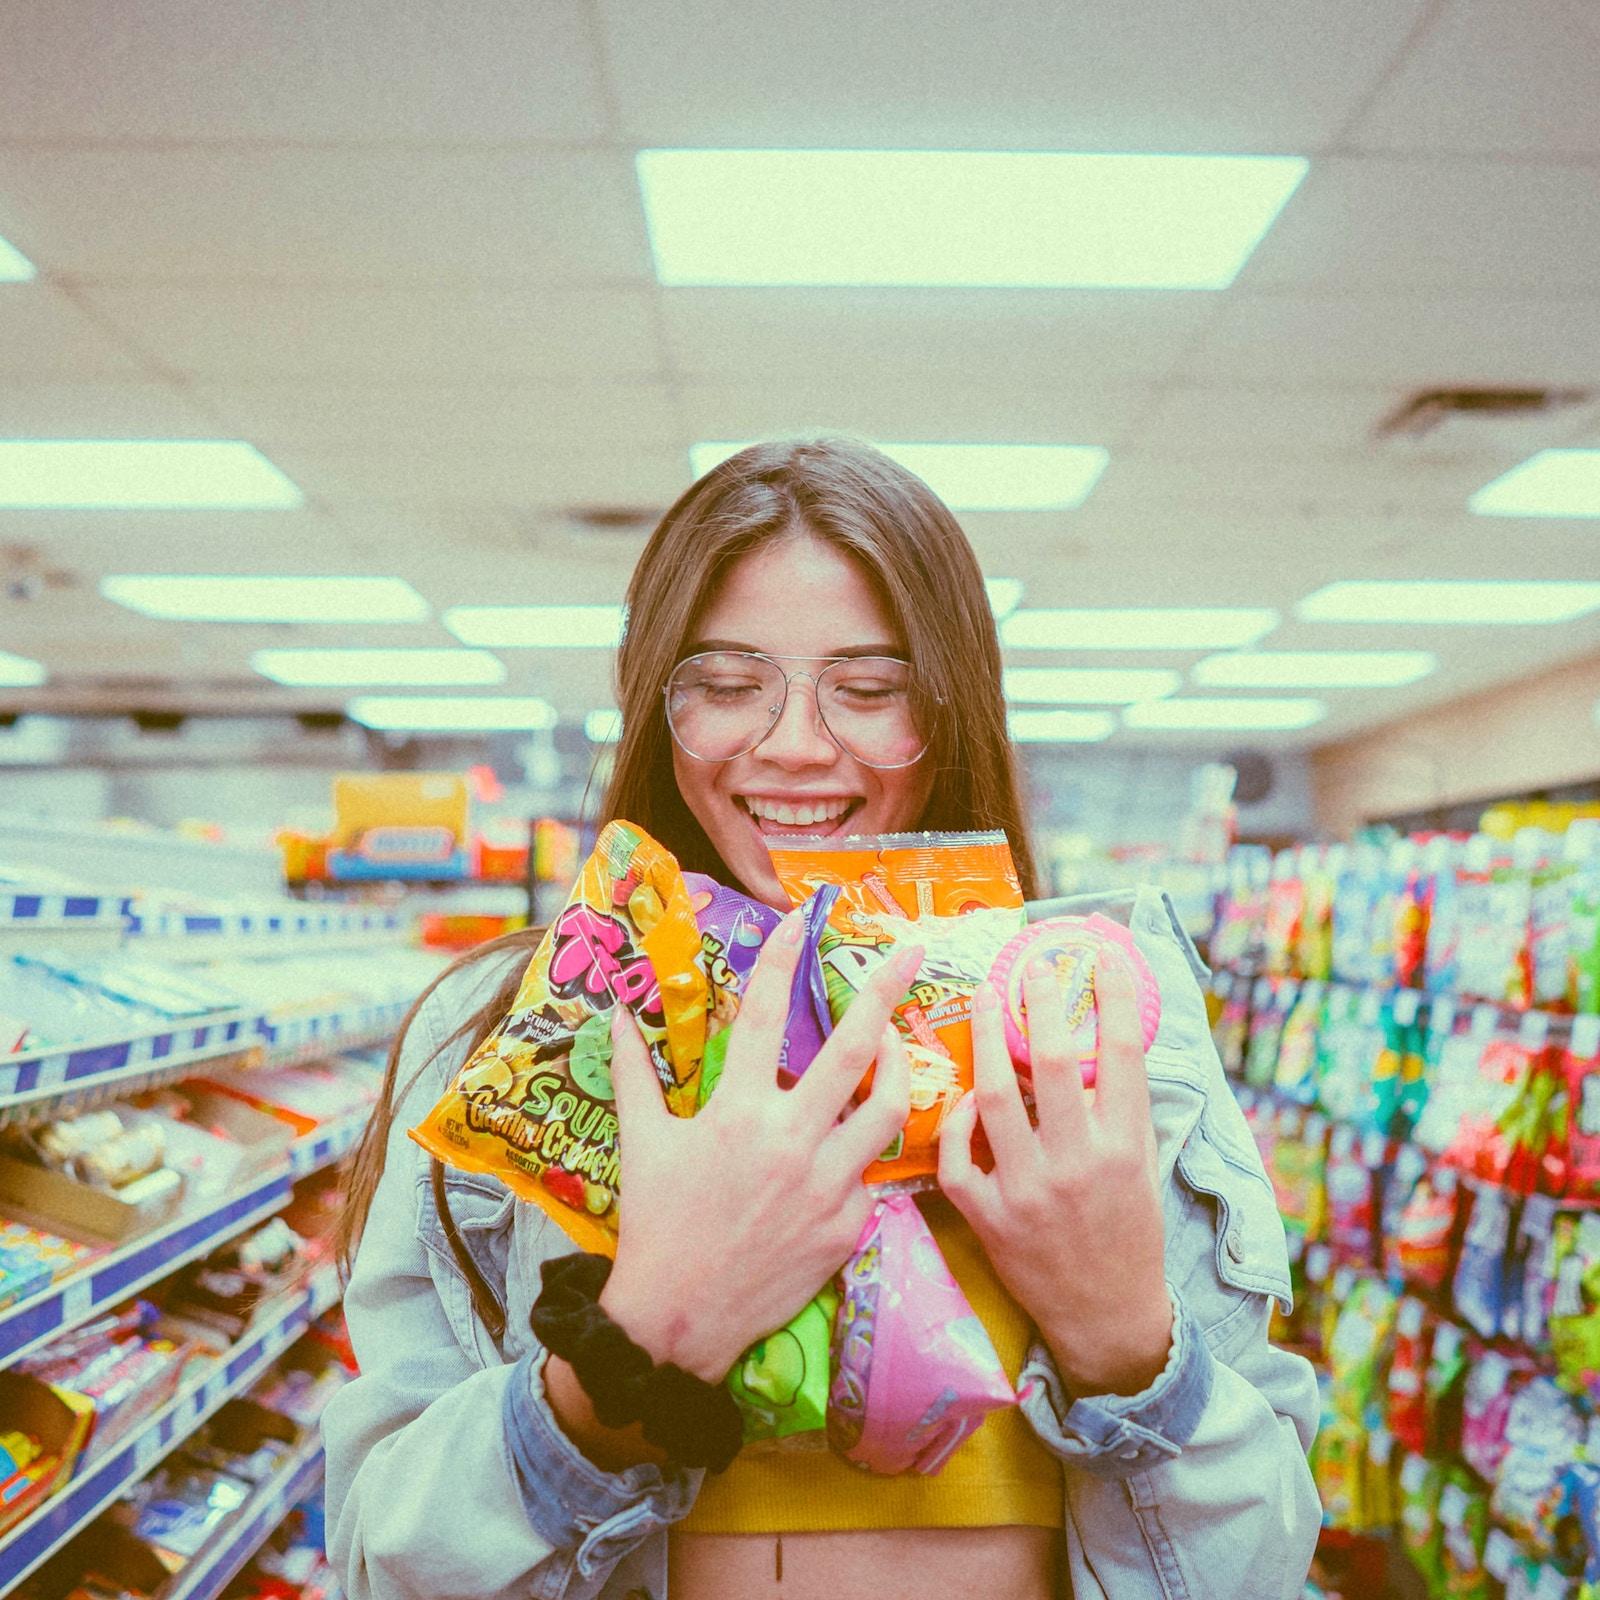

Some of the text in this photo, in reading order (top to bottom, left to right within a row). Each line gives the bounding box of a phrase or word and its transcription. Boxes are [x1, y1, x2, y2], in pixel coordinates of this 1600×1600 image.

[524, 1009, 564, 1036] Crunch
[523, 1076, 619, 1148] SOUR
[505, 1148, 541, 1174] ASSORTED
[541, 1121, 621, 1186] Crunch
